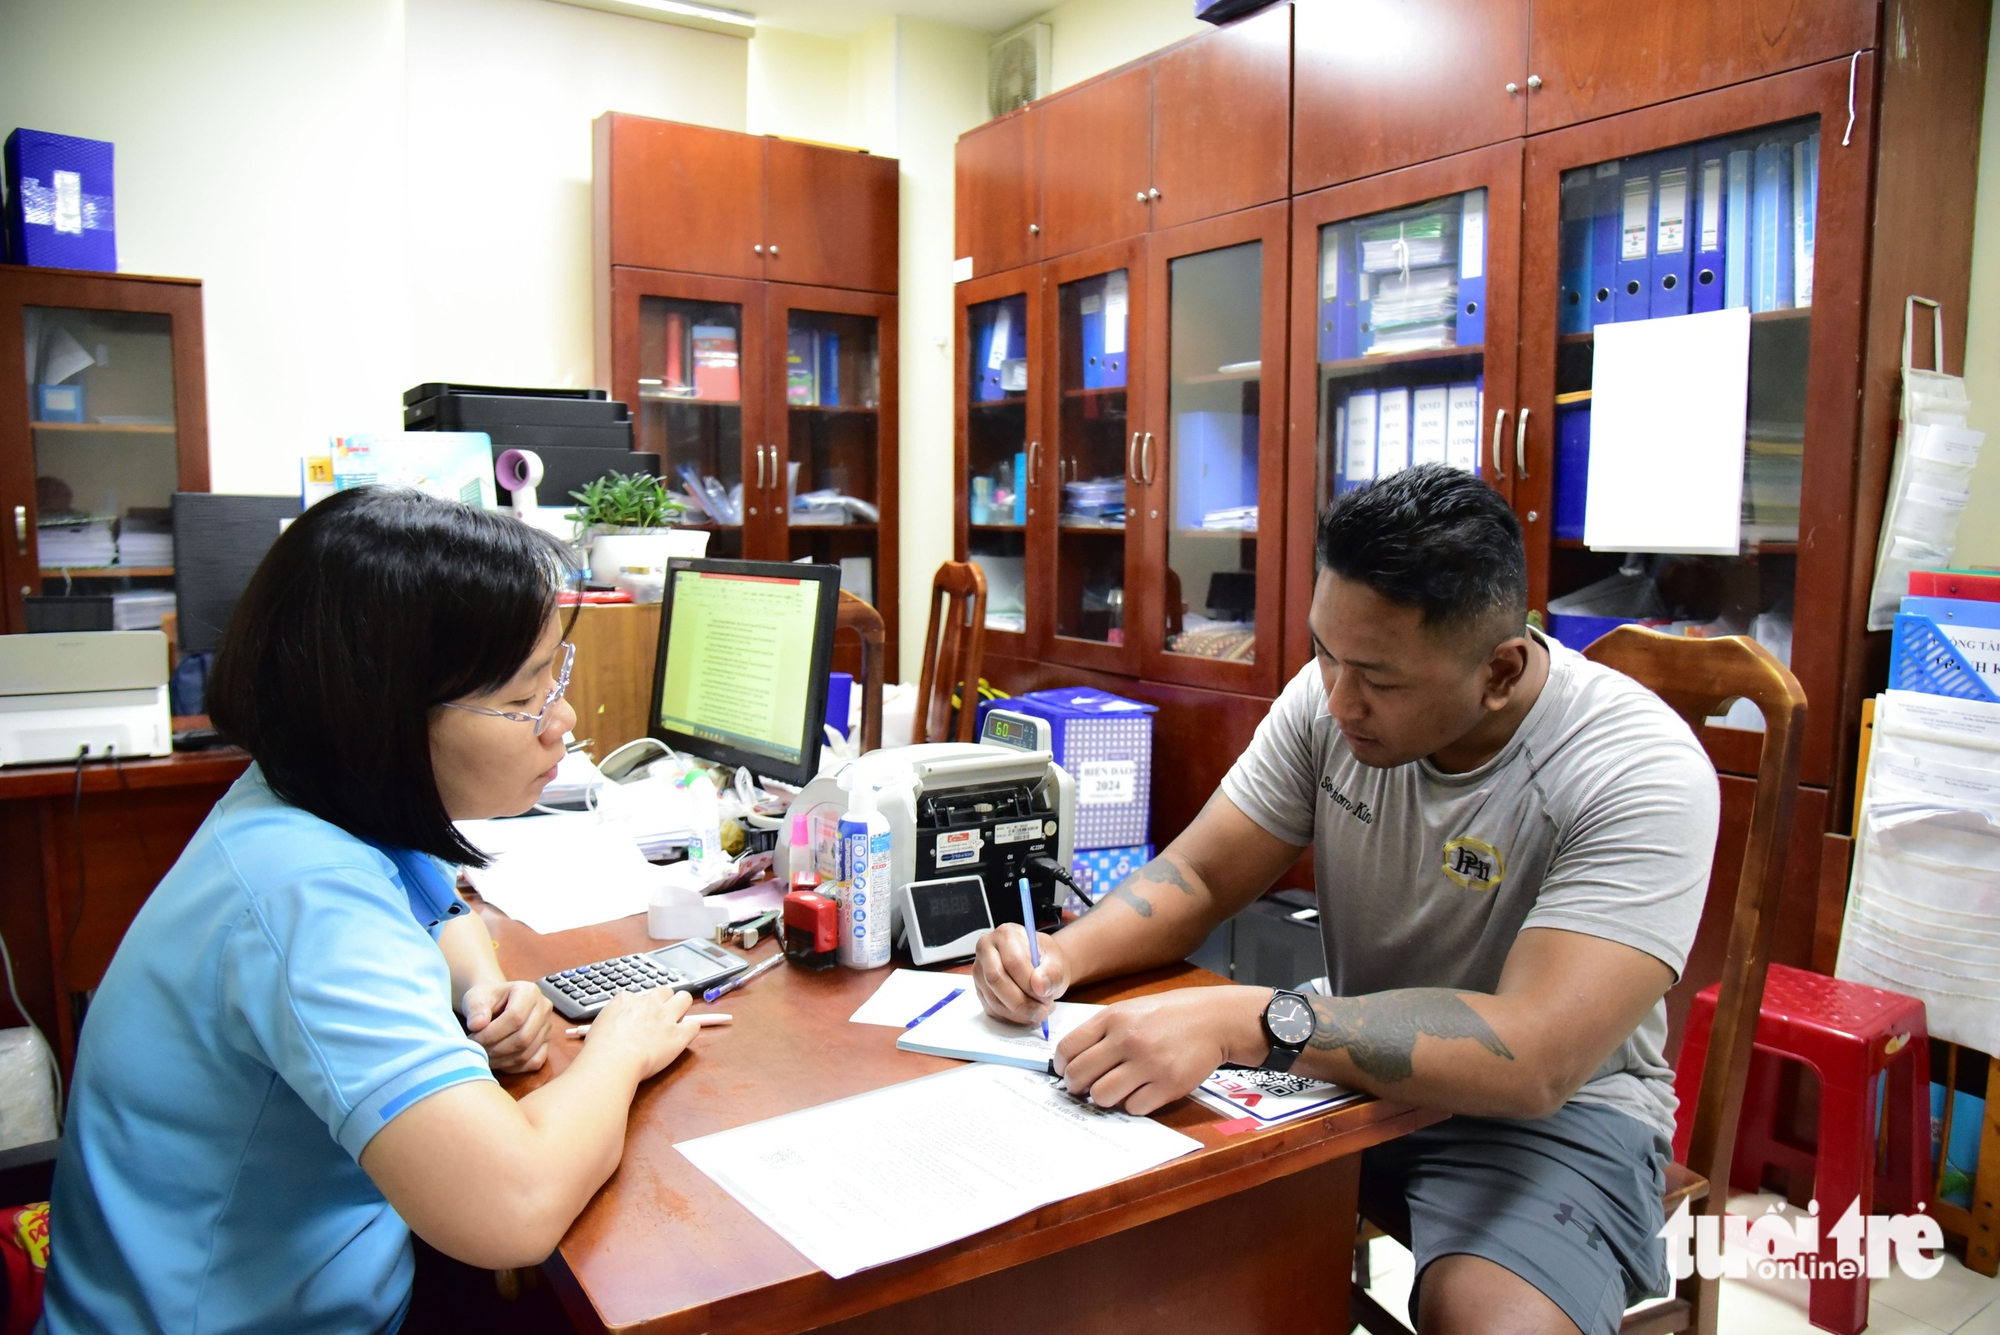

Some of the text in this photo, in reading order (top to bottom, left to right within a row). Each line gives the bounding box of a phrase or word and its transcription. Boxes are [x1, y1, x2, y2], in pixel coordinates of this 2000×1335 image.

[995, 721, 1009, 738] 60
[1096, 780, 1120, 791] 2024
[1352, 801, 1373, 824] Kin
